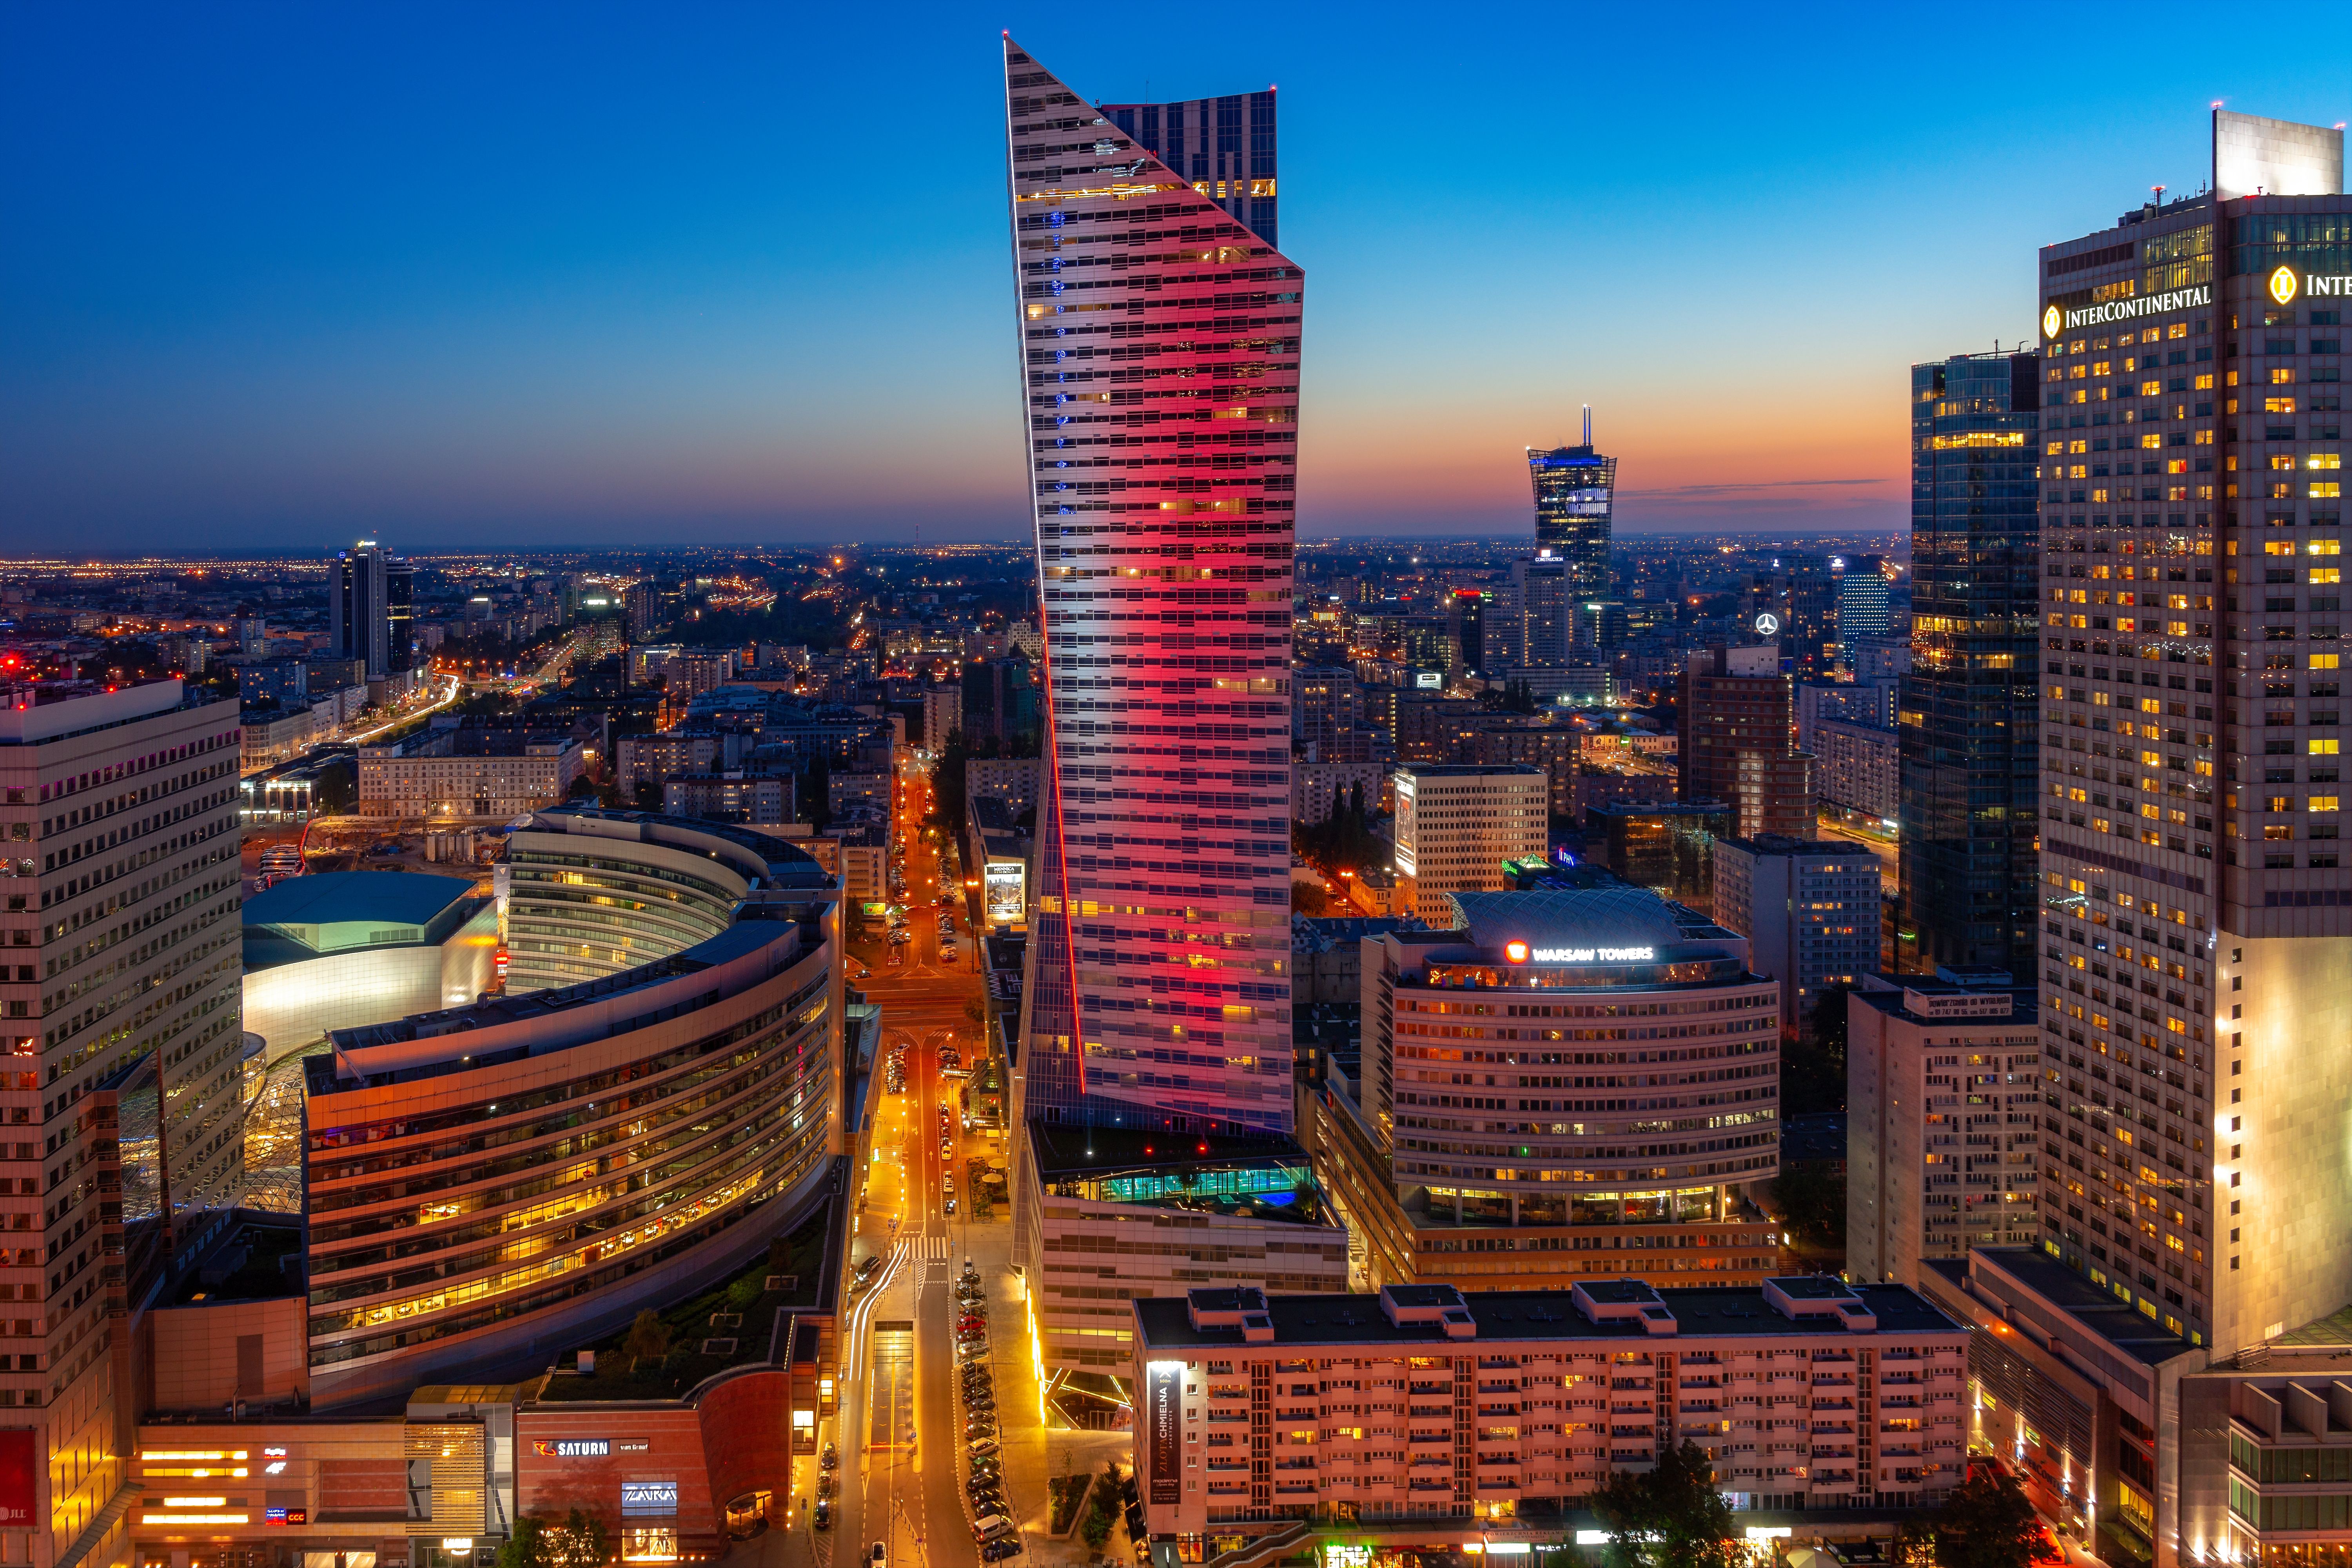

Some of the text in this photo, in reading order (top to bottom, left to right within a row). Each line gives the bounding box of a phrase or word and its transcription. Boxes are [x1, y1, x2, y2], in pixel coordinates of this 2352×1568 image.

[2307, 274, 2352, 295] INTE
[1564, 852, 1574, 866] PHN
[1533, 947, 1653, 961] WARSAW TOWERS
[558, 1442, 608, 1455] SATURN
[265, 1462, 287, 1474] 4F
[625, 1486, 677, 1501] ZARA
[9, 1509, 27, 1518] JLL
[650, 1540, 677, 1553] ZARA
